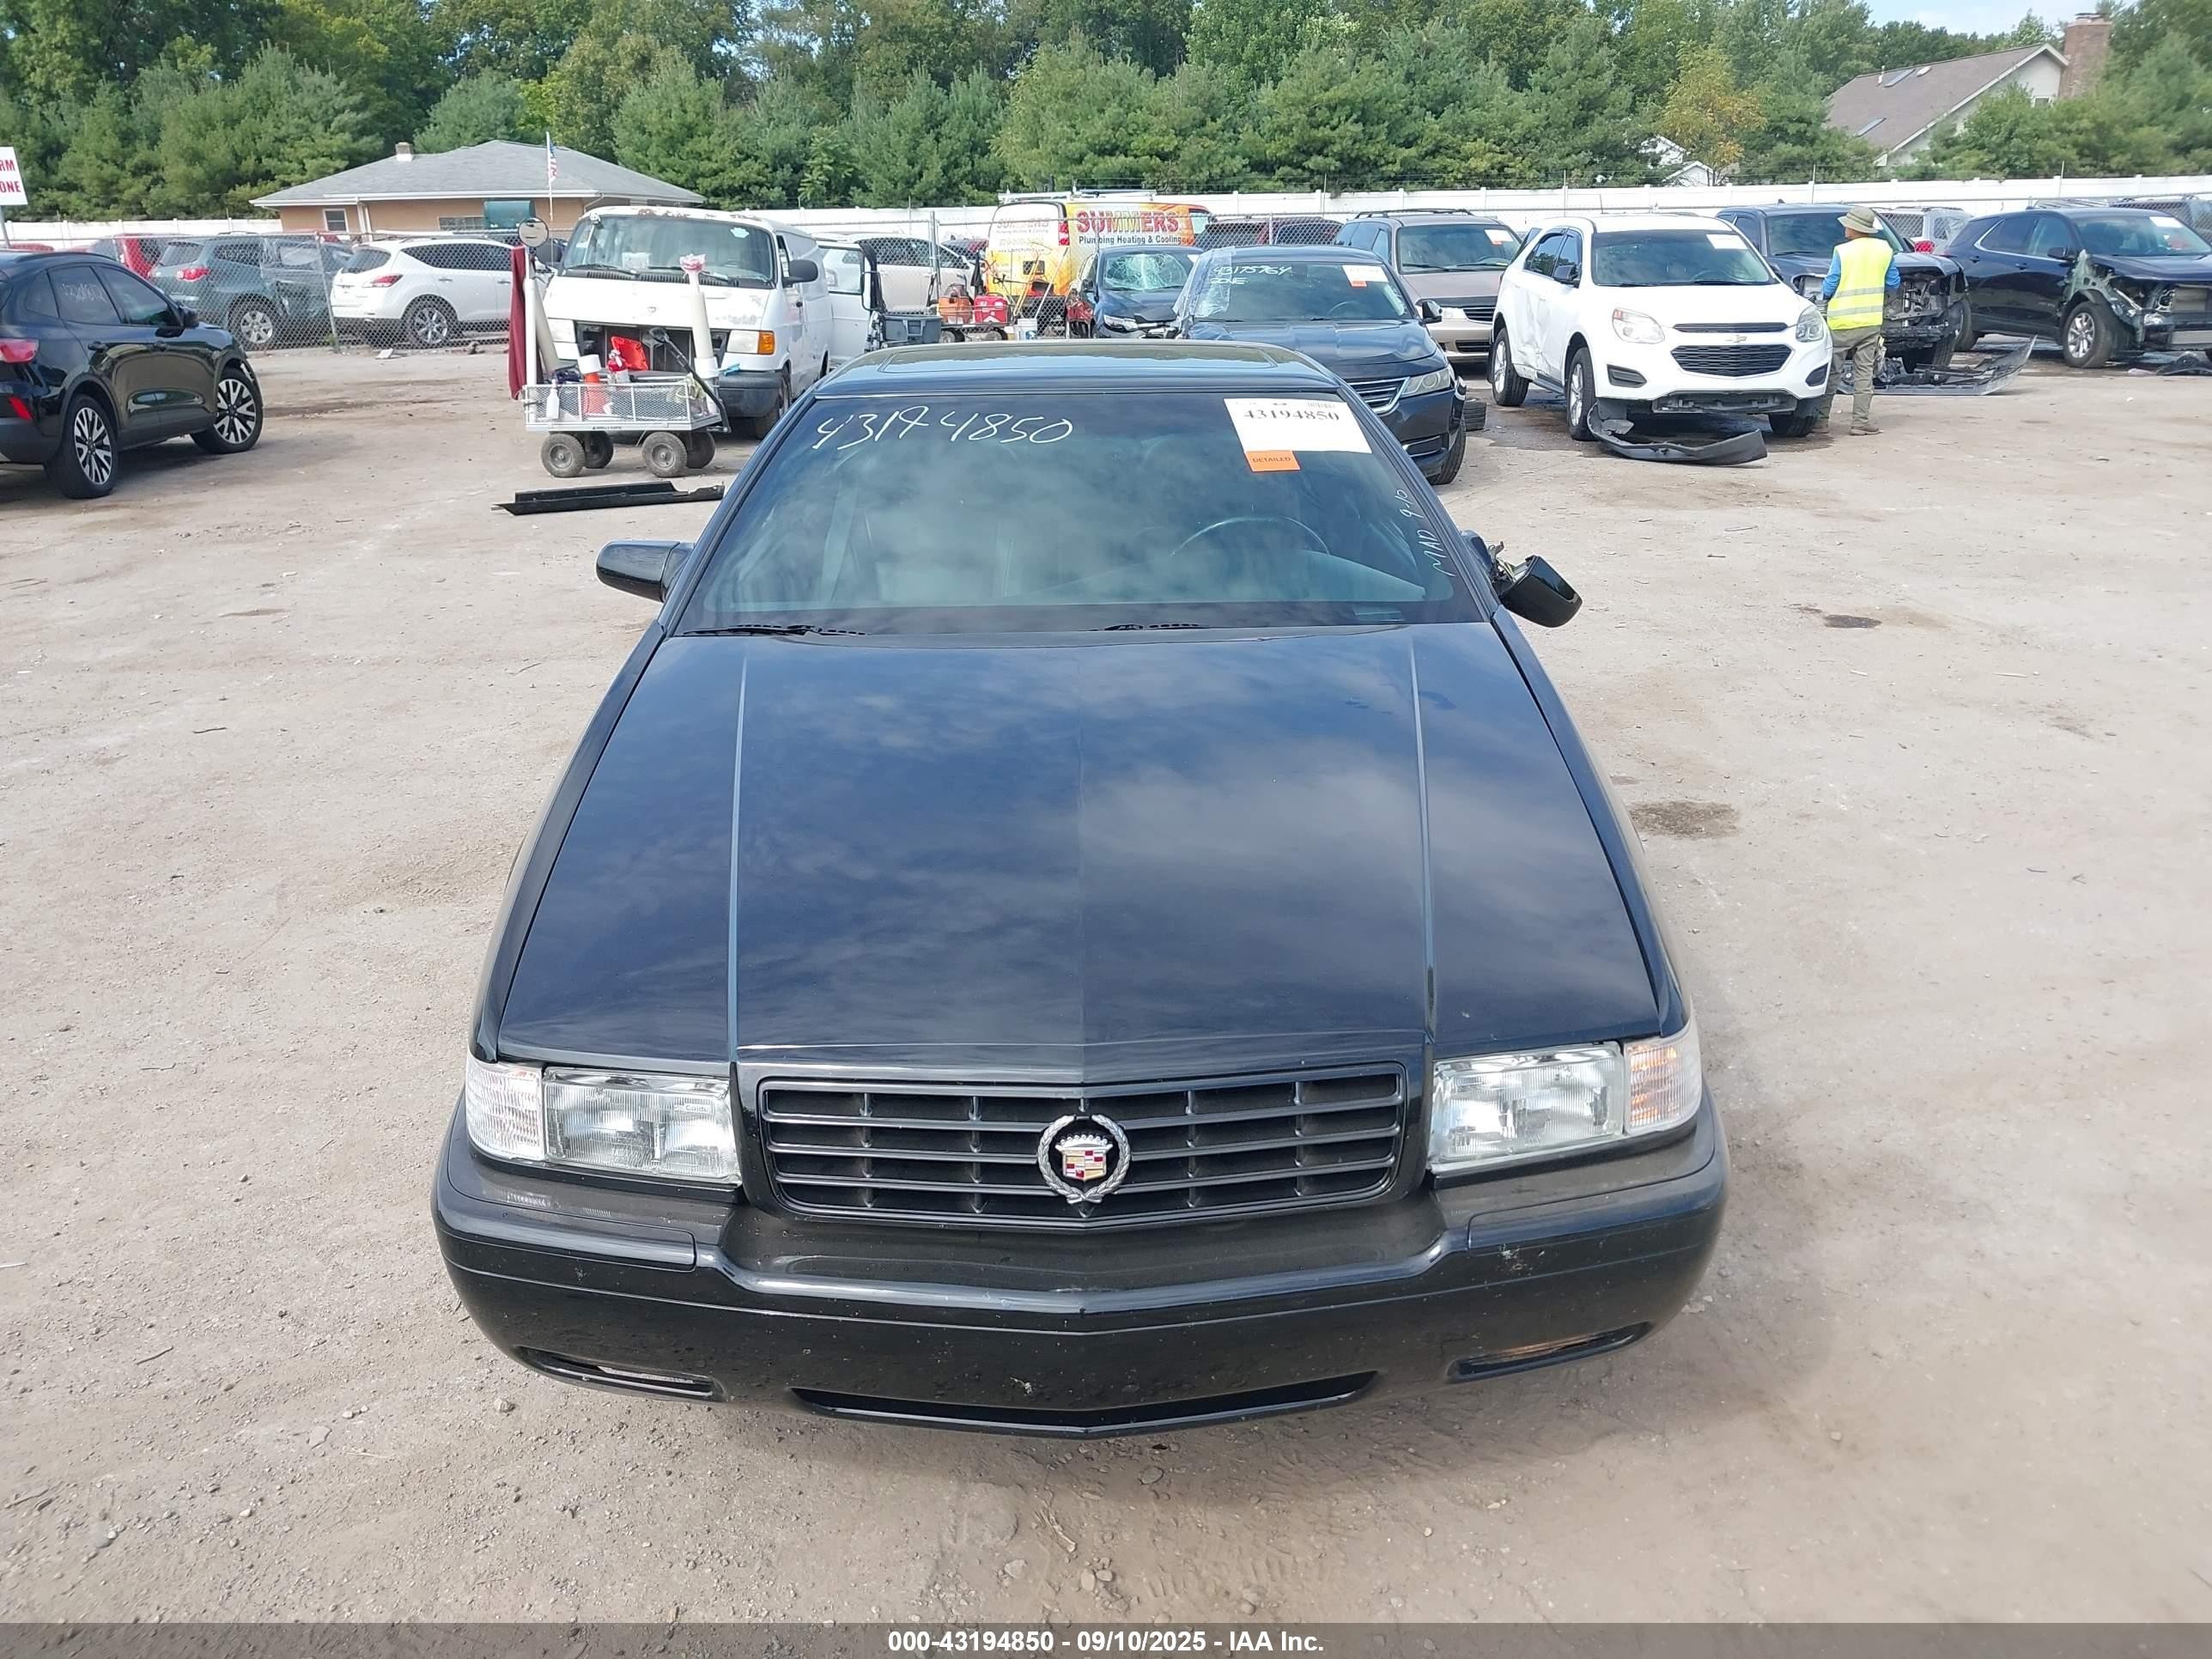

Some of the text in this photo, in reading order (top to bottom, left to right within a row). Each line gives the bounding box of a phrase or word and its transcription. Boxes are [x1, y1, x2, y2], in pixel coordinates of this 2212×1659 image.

[1077, 211, 1179, 233] SUMMERS
[1117, 235, 1146, 245] Heating
[1156, 234, 1182, 245] Cooling
[1243, 410, 1340, 421] 43194850
[1395, 489, 1425, 519] 9-10
